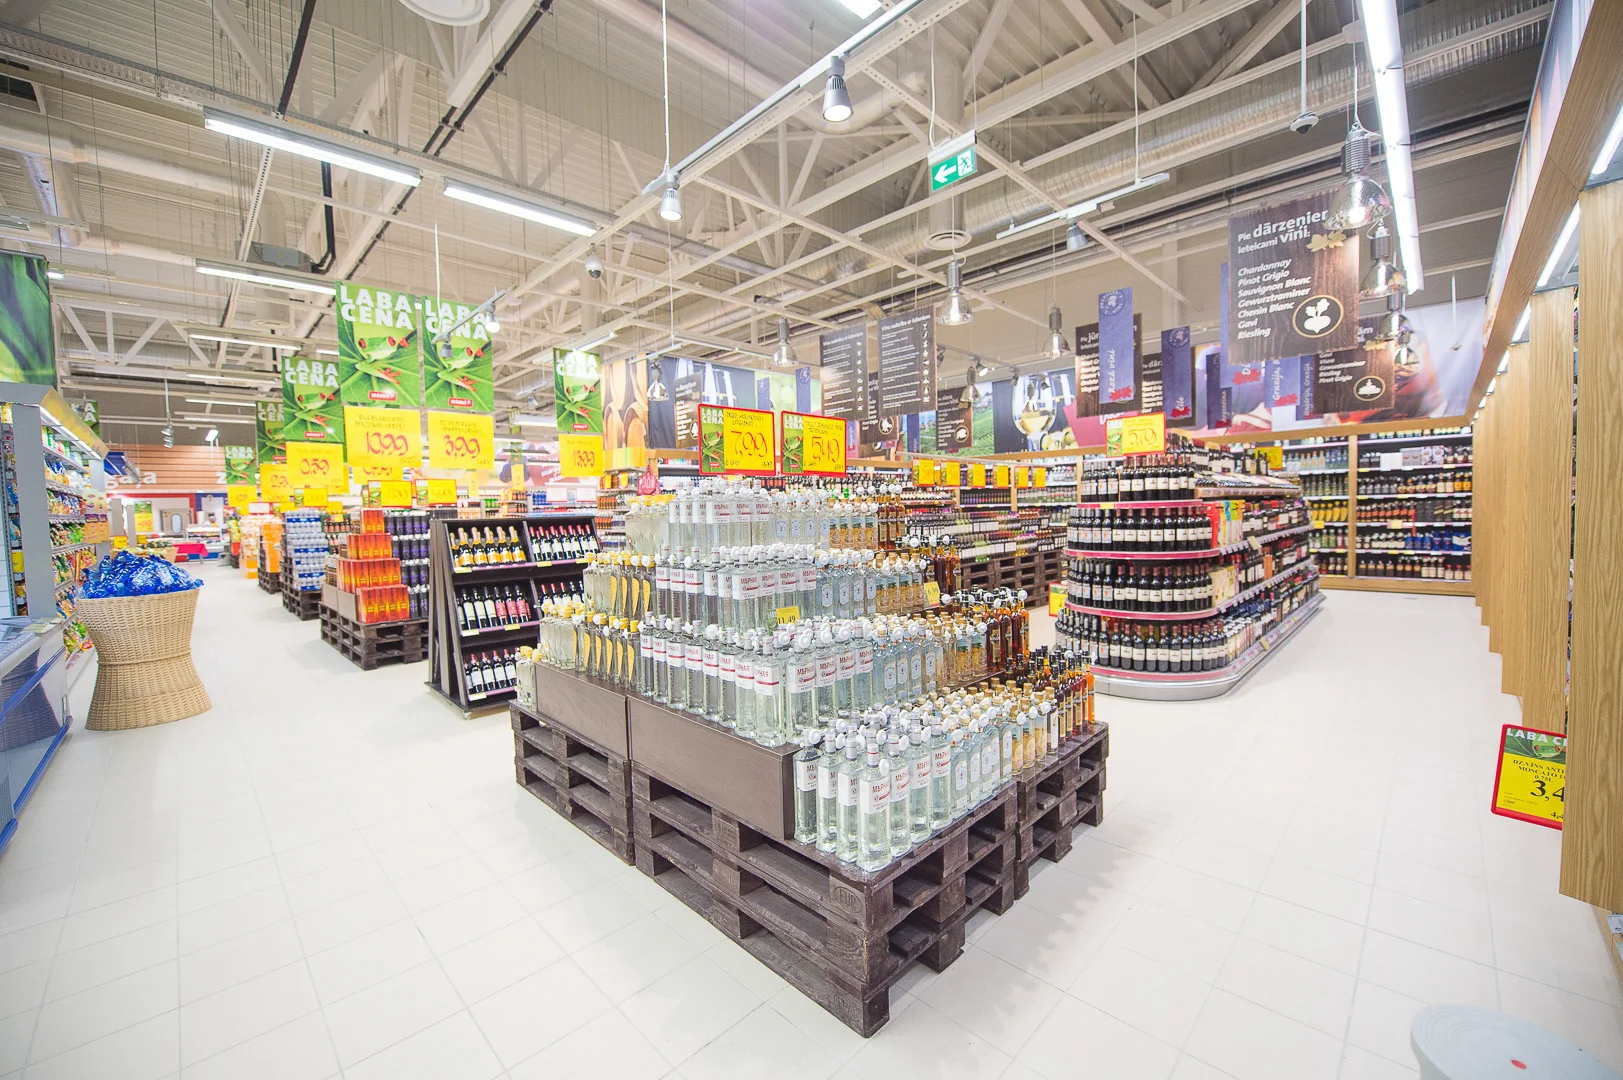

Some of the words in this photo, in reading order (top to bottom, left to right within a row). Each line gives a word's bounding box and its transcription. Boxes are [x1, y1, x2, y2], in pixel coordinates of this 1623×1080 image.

[1238, 232, 1251, 242] Pie
[1238, 237, 1278, 254] ieteicami
[1238, 258, 1292, 277] Chardonnay
[1238, 275, 1260, 287] Pinot
[1262, 269, 1290, 283] Grigio
[1238, 281, 1283, 298] Sauvignon
[1285, 275, 1311, 287] Blanc
[340, 285, 412, 314] LABA
[1238, 288, 1311, 308] Gewurztraminer
[341, 304, 414, 330] CENA
[425, 299, 487, 326] LABA
[1238, 307, 1267, 319] Chenin
[1269, 302, 1295, 313] Blanc
[426, 316, 489, 341] CENA
[1238, 318, 1258, 329] Gavi
[1238, 327, 1271, 340] Riesling
[285, 358, 339, 377] LABA
[556, 364, 600, 379] CENA
[285, 372, 339, 388] CENA
[701, 408, 723, 417] LABA
[701, 415, 724, 424] CENA
[366, 431, 409, 456] 10,99
[443, 434, 481, 459] 3,99
[731, 430, 768, 458] 7,99
[812, 436, 840, 463] 5,49
[300, 458, 330, 475] 0,59
[1506, 728, 1548, 743] LABA
[1518, 766, 1558, 778] MOSCATO
[839, 888, 857, 911] EUR
